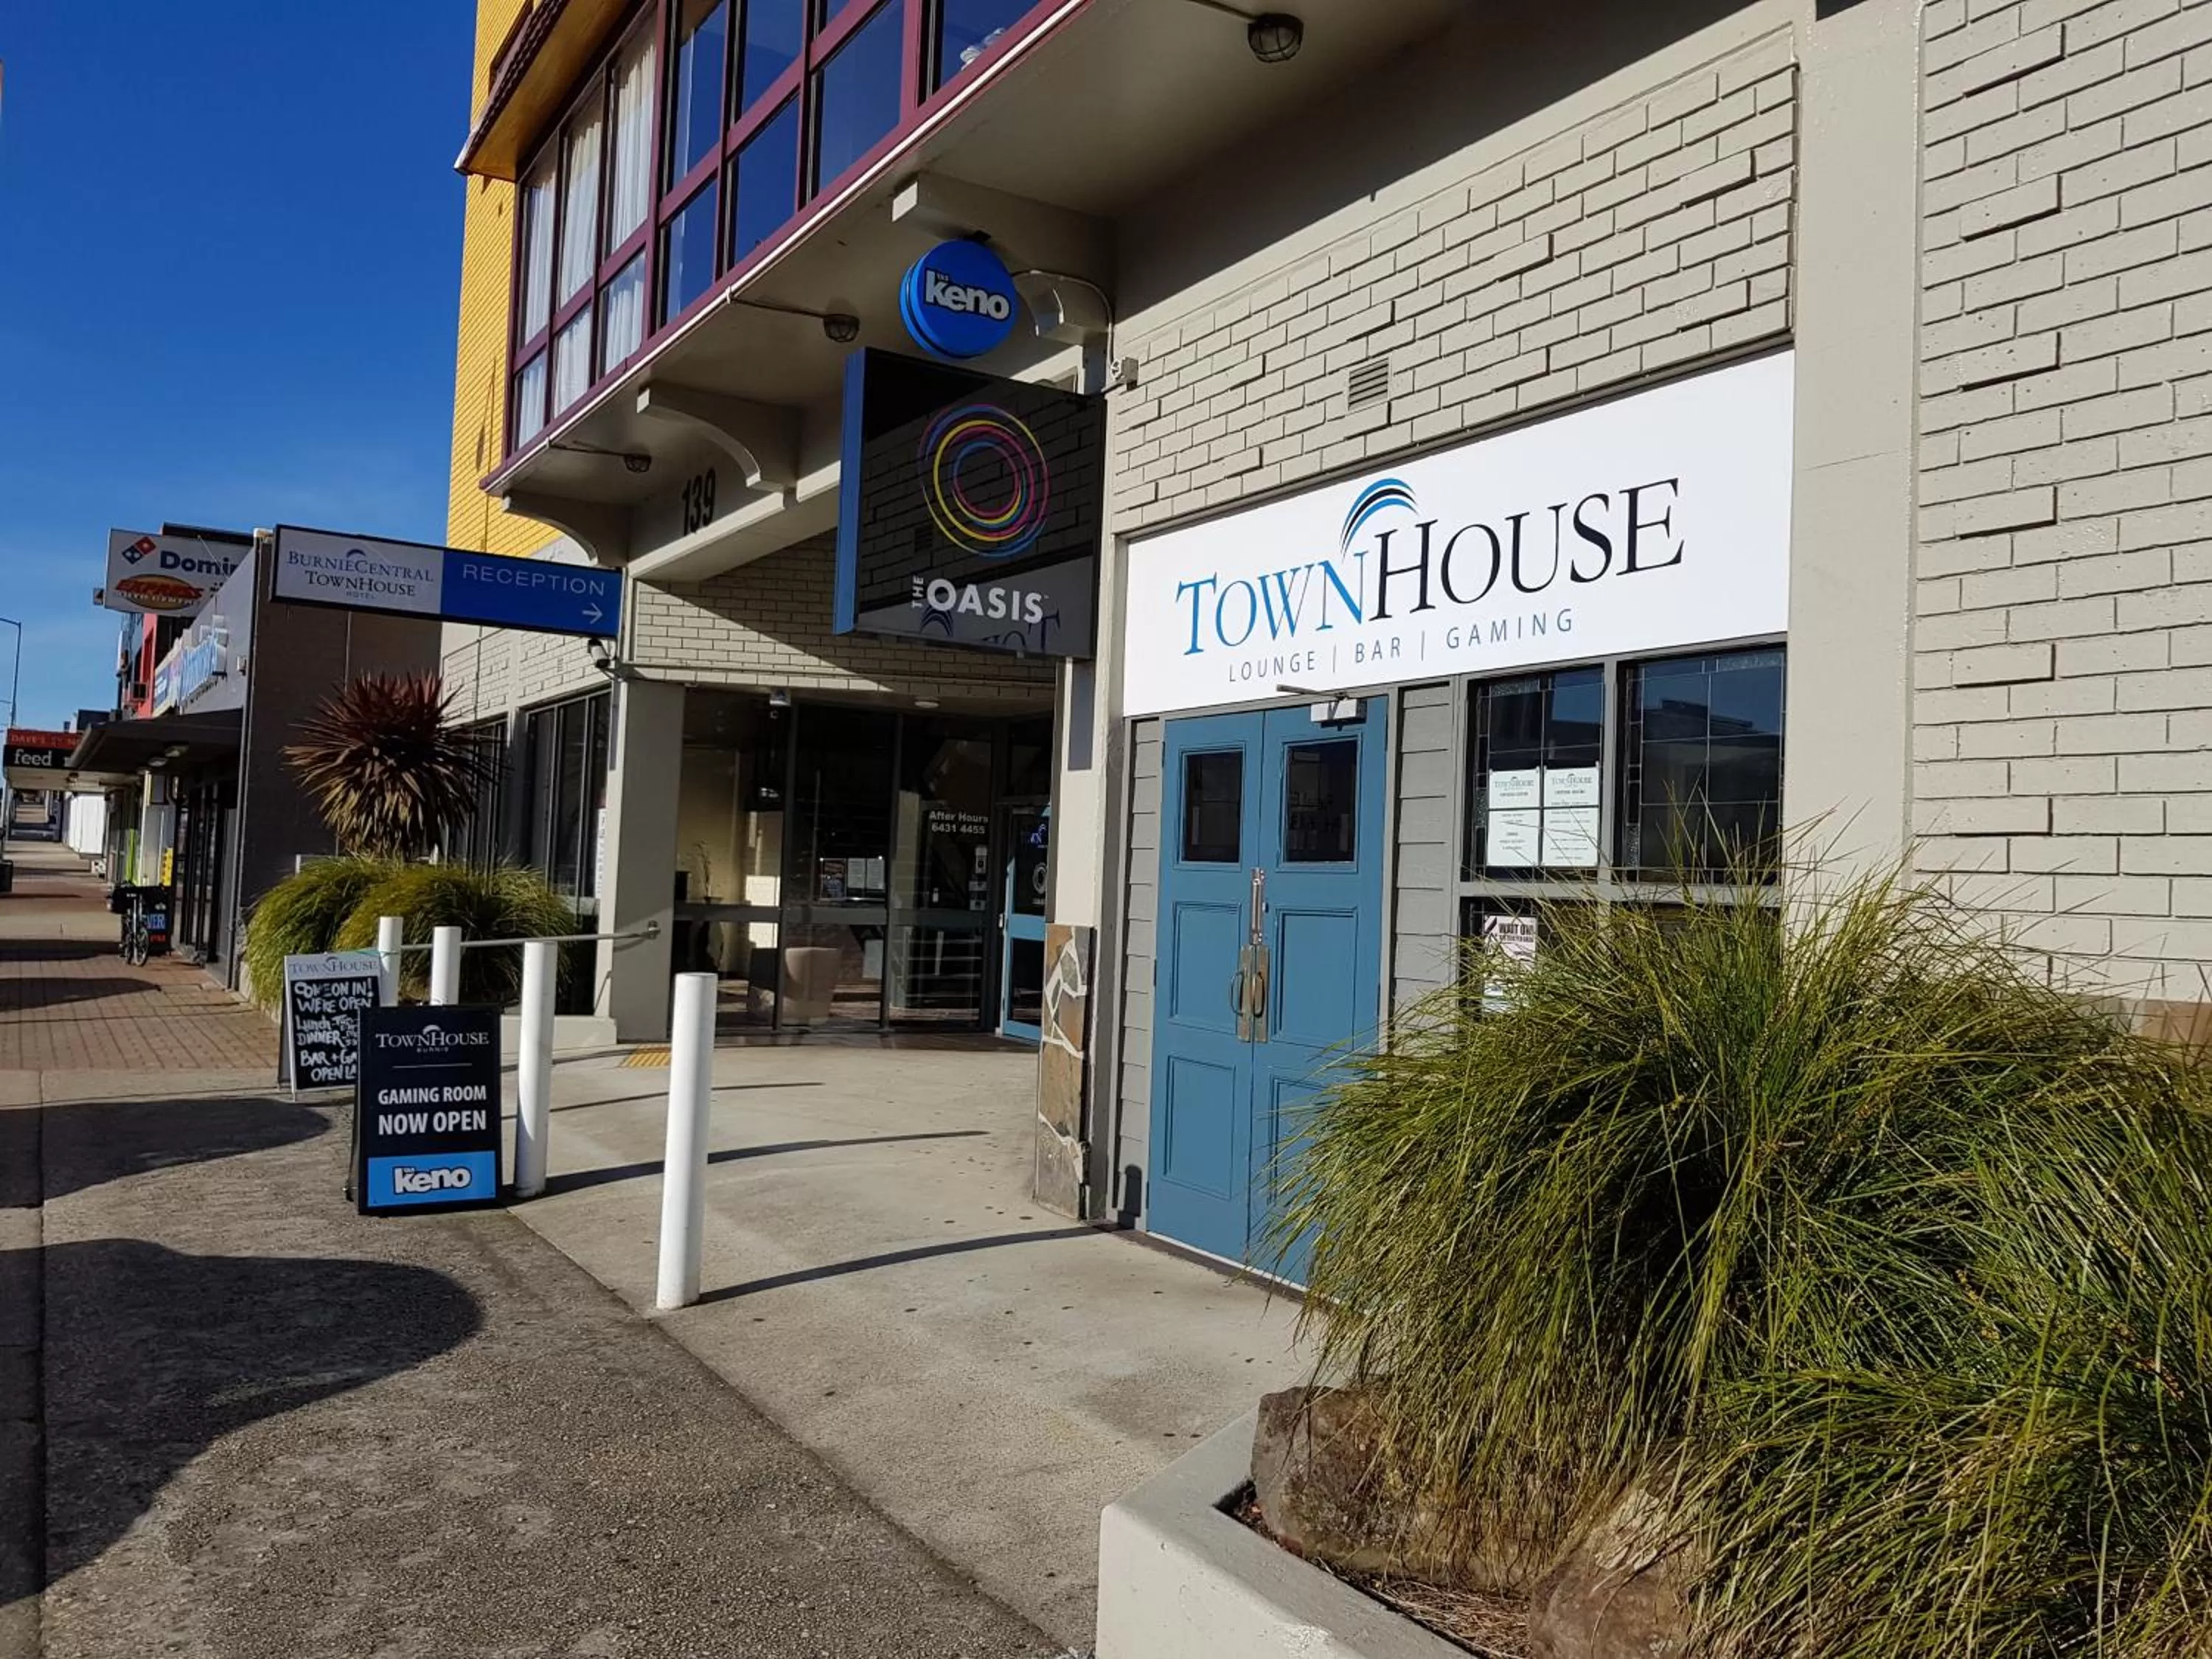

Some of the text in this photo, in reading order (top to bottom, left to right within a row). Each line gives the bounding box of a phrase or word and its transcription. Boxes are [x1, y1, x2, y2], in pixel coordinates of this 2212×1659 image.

[925, 270, 1010, 319] keno
[682, 466, 716, 536] 139
[1175, 477, 1685, 655] TOWNHOUSE
[305, 570, 416, 597] TOWNHOUSE
[463, 563, 605, 597] RECEPTION
[346, 591, 376, 599] HOTEL
[911, 575, 924, 608] THE
[927, 578, 1043, 624] OASIS
[1229, 608, 1573, 682] LOUNGE BAR GAMING
[14, 748, 53, 767] feed
[929, 811, 989, 823] After Hours
[931, 823, 986, 834] 6431 4455
[288, 961, 378, 973] TOWNHOUSE
[331, 981, 349, 996] ON
[352, 977, 374, 997] IN!
[339, 996, 372, 1011] OPEN
[375, 1032, 490, 1048] TOWNHOUSE
[300, 1049, 332, 1067] BAR
[310, 1064, 344, 1082] OPEN
[378, 1085, 487, 1105] GAMING ROOM
[378, 1110, 487, 1135] NOW OPEN
[394, 1167, 471, 1194] keno
